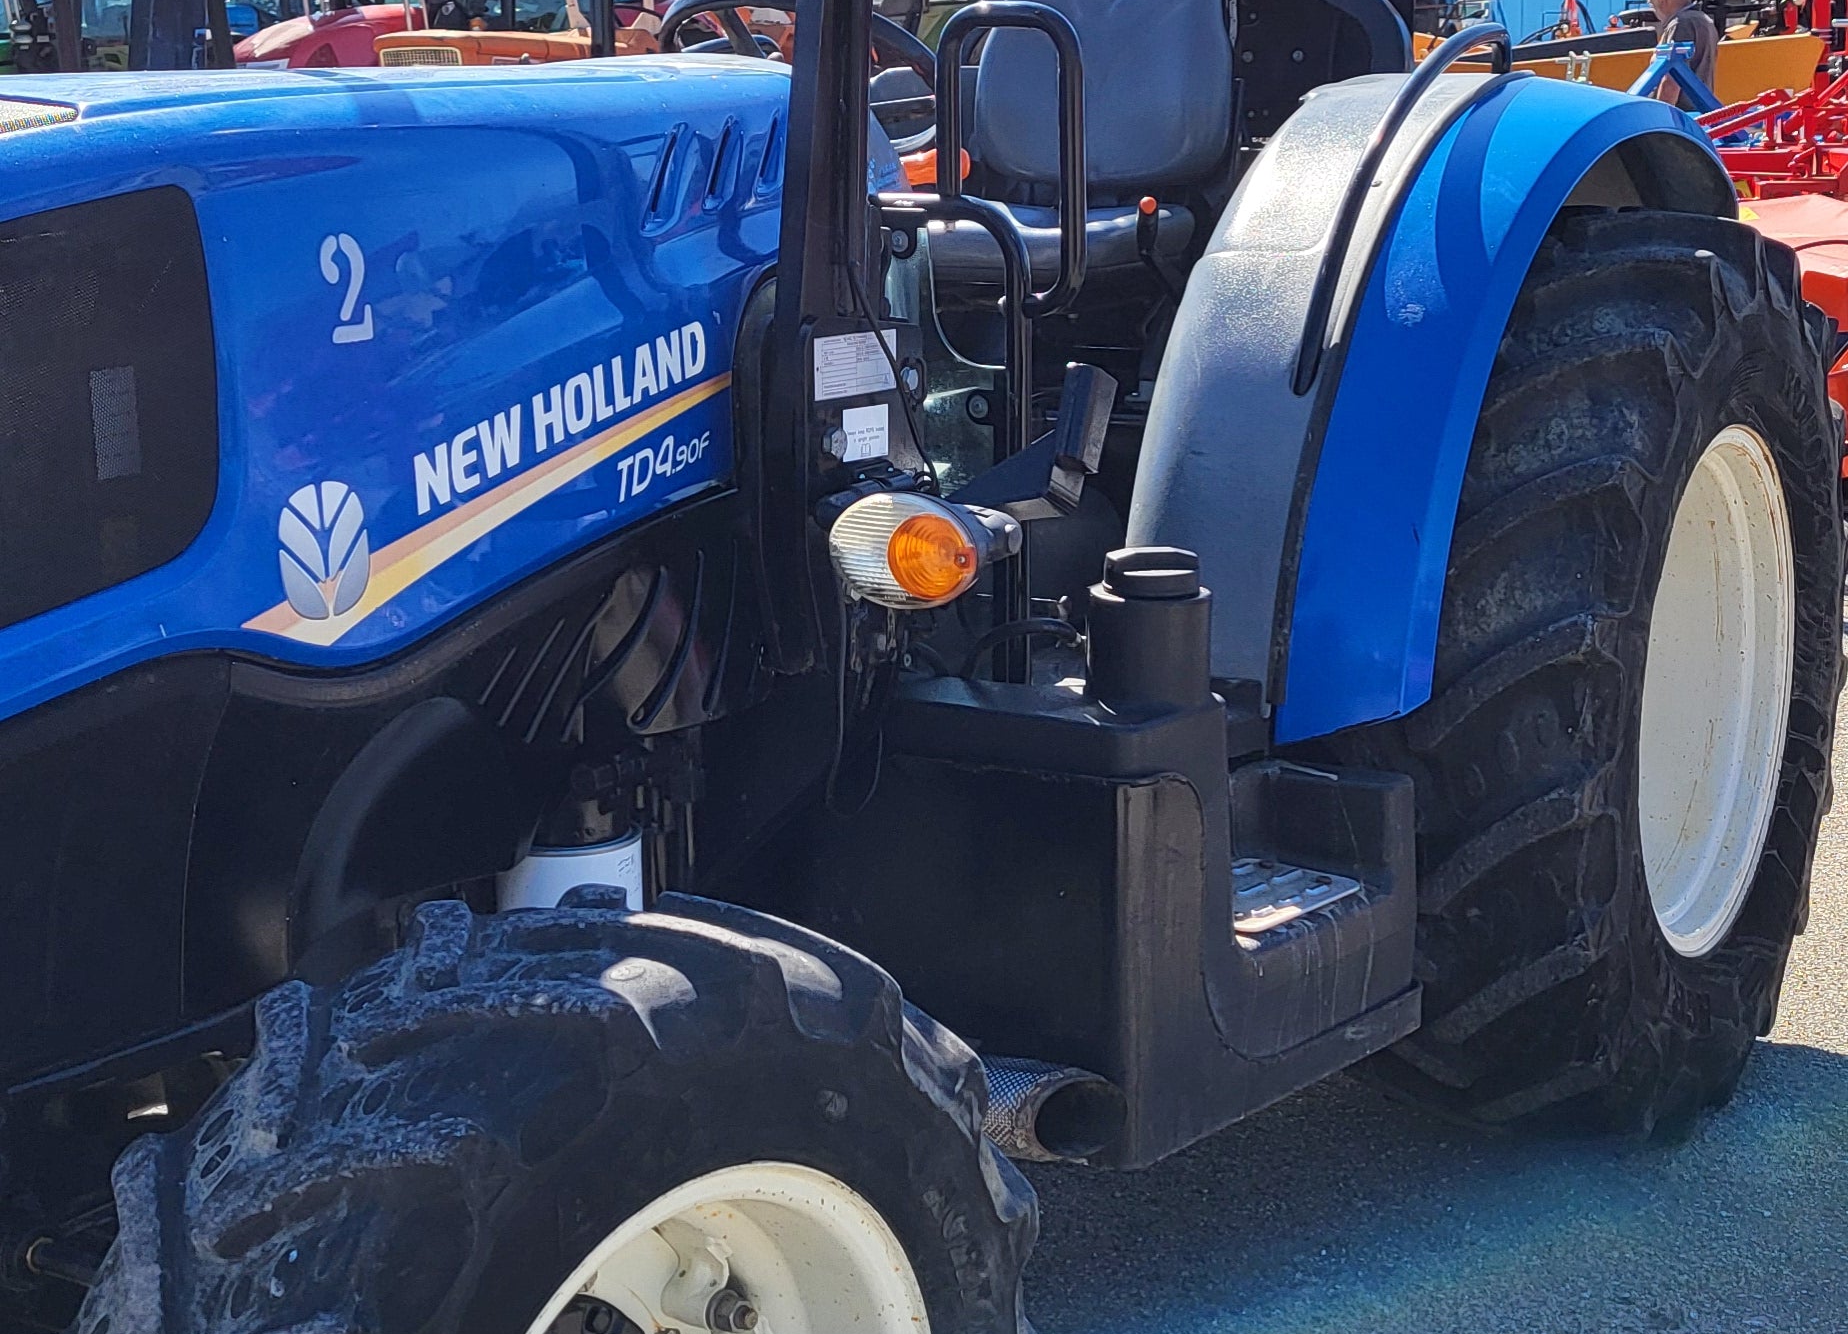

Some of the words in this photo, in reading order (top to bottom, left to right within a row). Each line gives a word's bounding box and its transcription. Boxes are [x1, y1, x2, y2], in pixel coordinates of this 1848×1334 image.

[320, 233, 374, 344] 2
[413, 403, 521, 516] NEW
[532, 320, 706, 454] HOLLAND
[616, 430, 711, 504] TD4.90F
